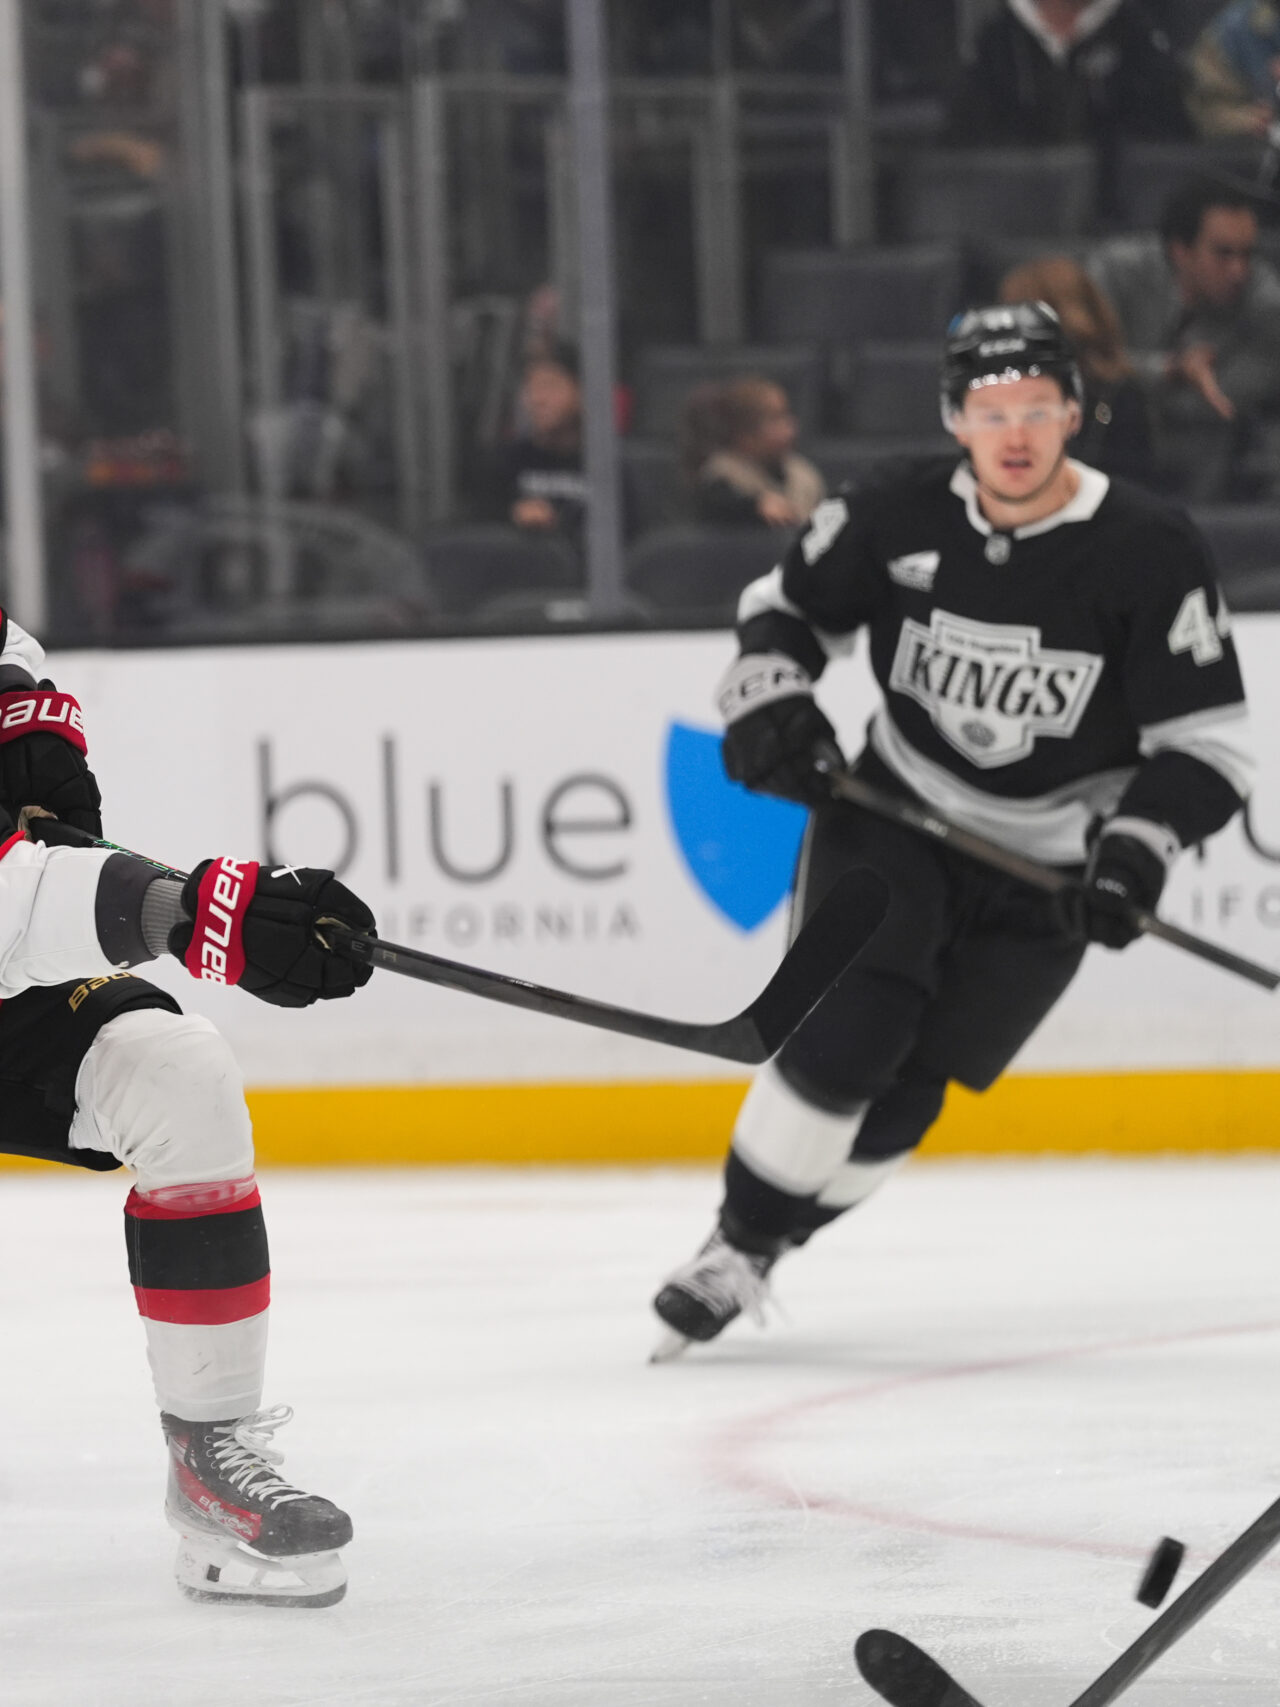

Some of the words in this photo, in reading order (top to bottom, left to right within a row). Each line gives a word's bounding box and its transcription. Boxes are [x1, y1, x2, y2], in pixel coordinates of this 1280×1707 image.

[910, 640, 1079, 720] KINGS
[257, 732, 635, 885] blue
[382, 902, 643, 947] IFORNIA
